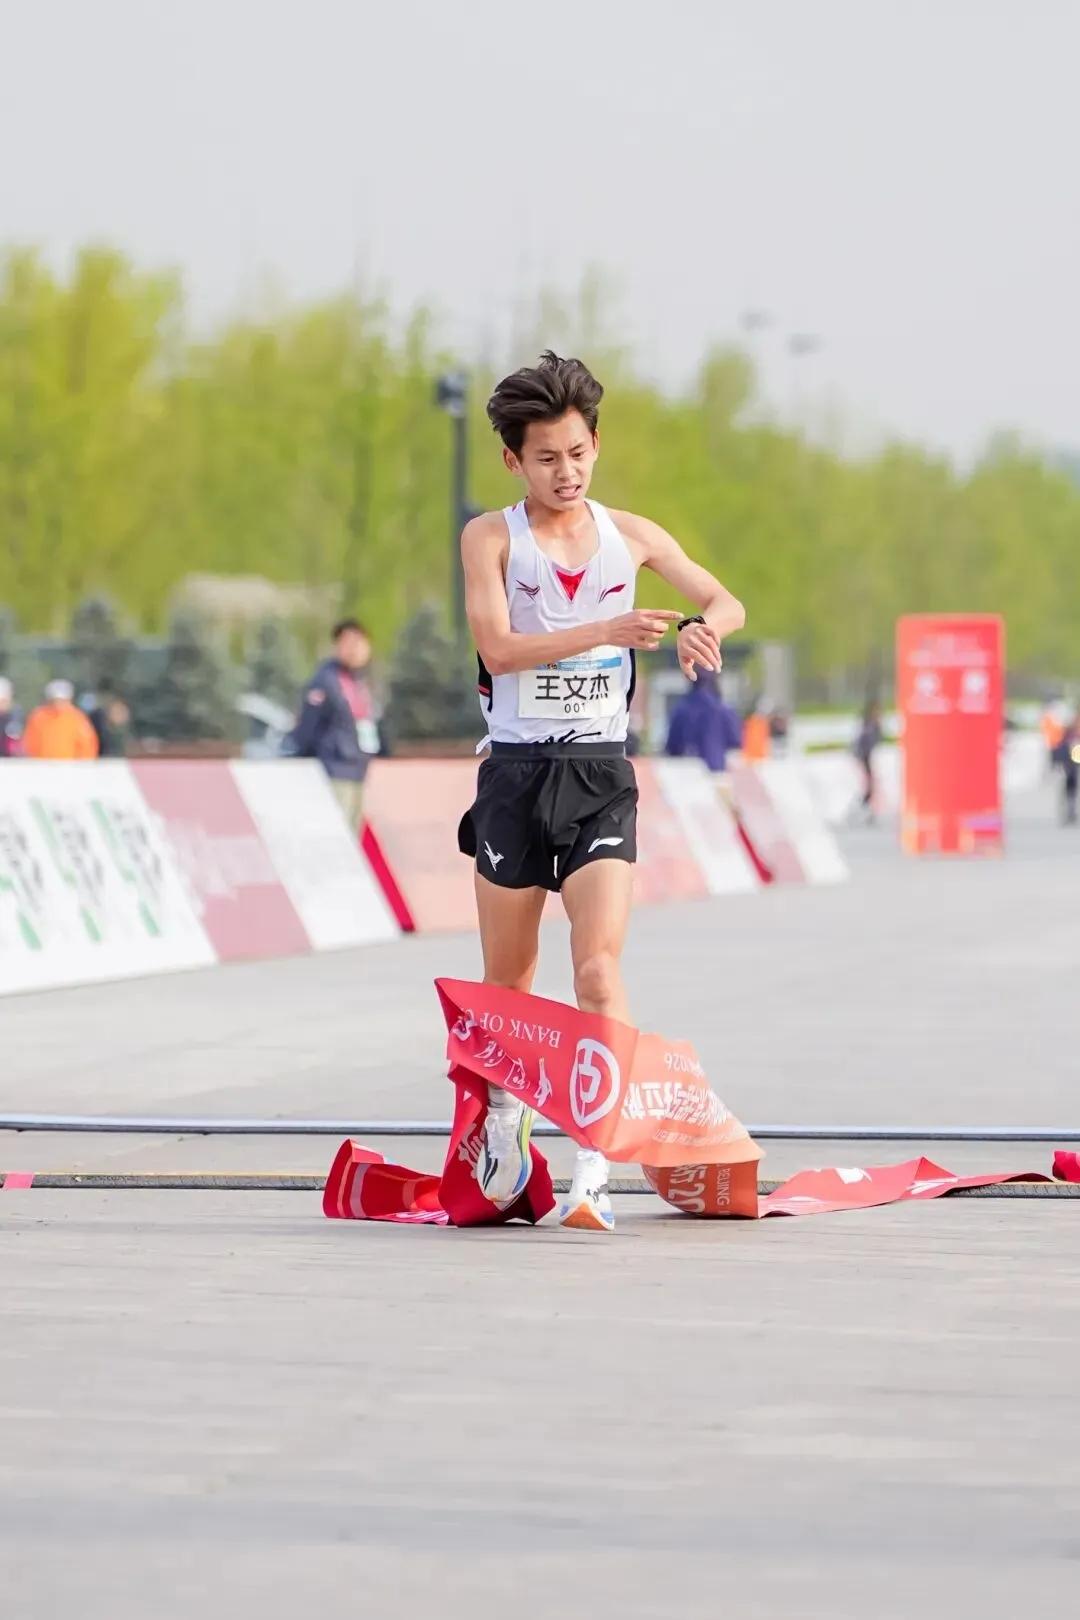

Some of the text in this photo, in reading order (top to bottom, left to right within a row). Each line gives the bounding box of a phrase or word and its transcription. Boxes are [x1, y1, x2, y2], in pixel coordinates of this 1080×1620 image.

[535, 673, 610, 701] 王文杰
[479, 1012, 504, 1033] OF
[508, 1018, 562, 1049] BANK
[716, 1168, 731, 1206] BEIJING
